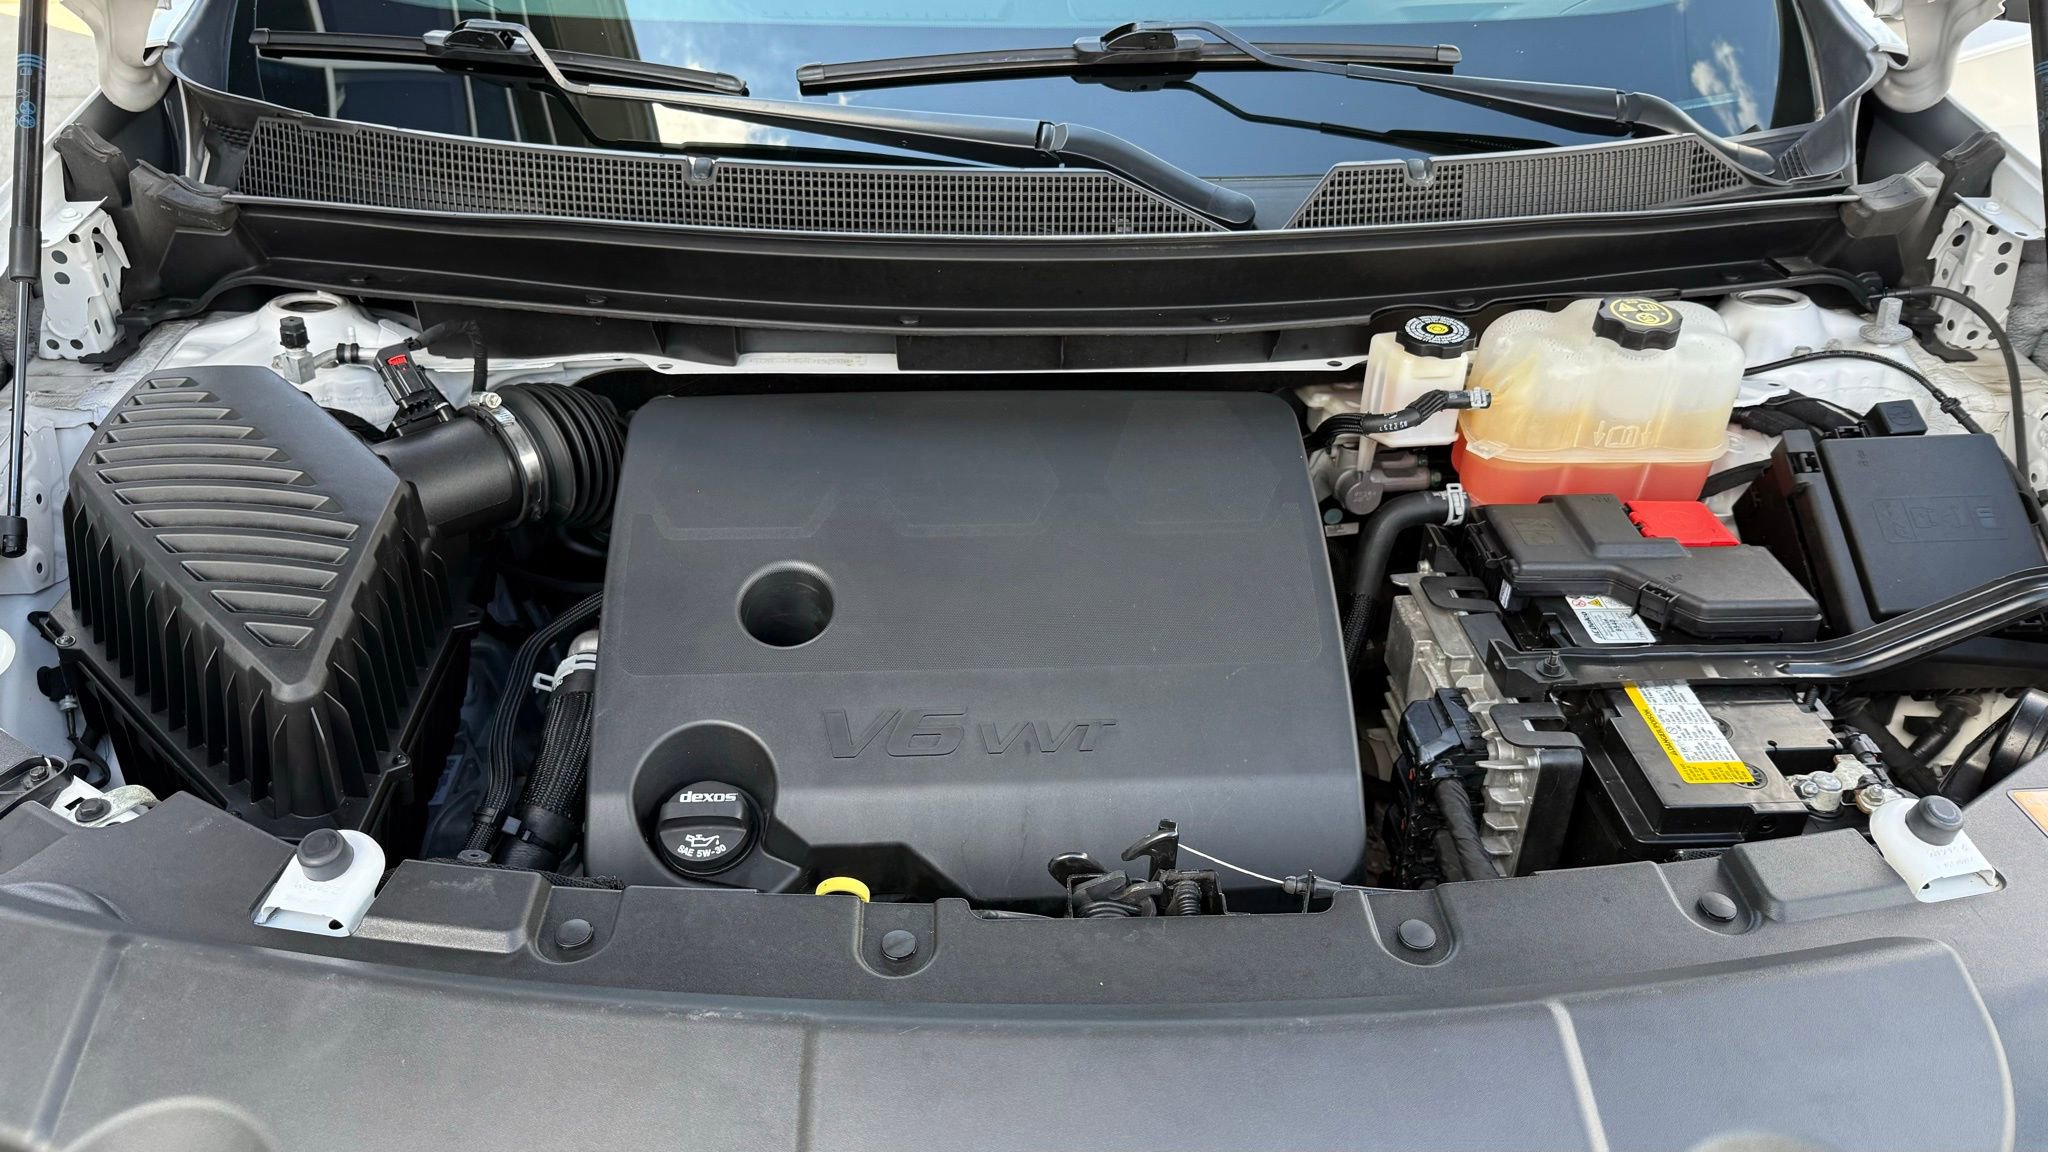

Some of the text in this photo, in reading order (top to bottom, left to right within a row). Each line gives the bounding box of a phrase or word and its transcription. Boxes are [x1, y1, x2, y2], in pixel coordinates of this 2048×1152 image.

[822, 706, 1118, 758] V6 VVT
[680, 791, 738, 803] dexos
[677, 844, 727, 858] SAE 5W-30
